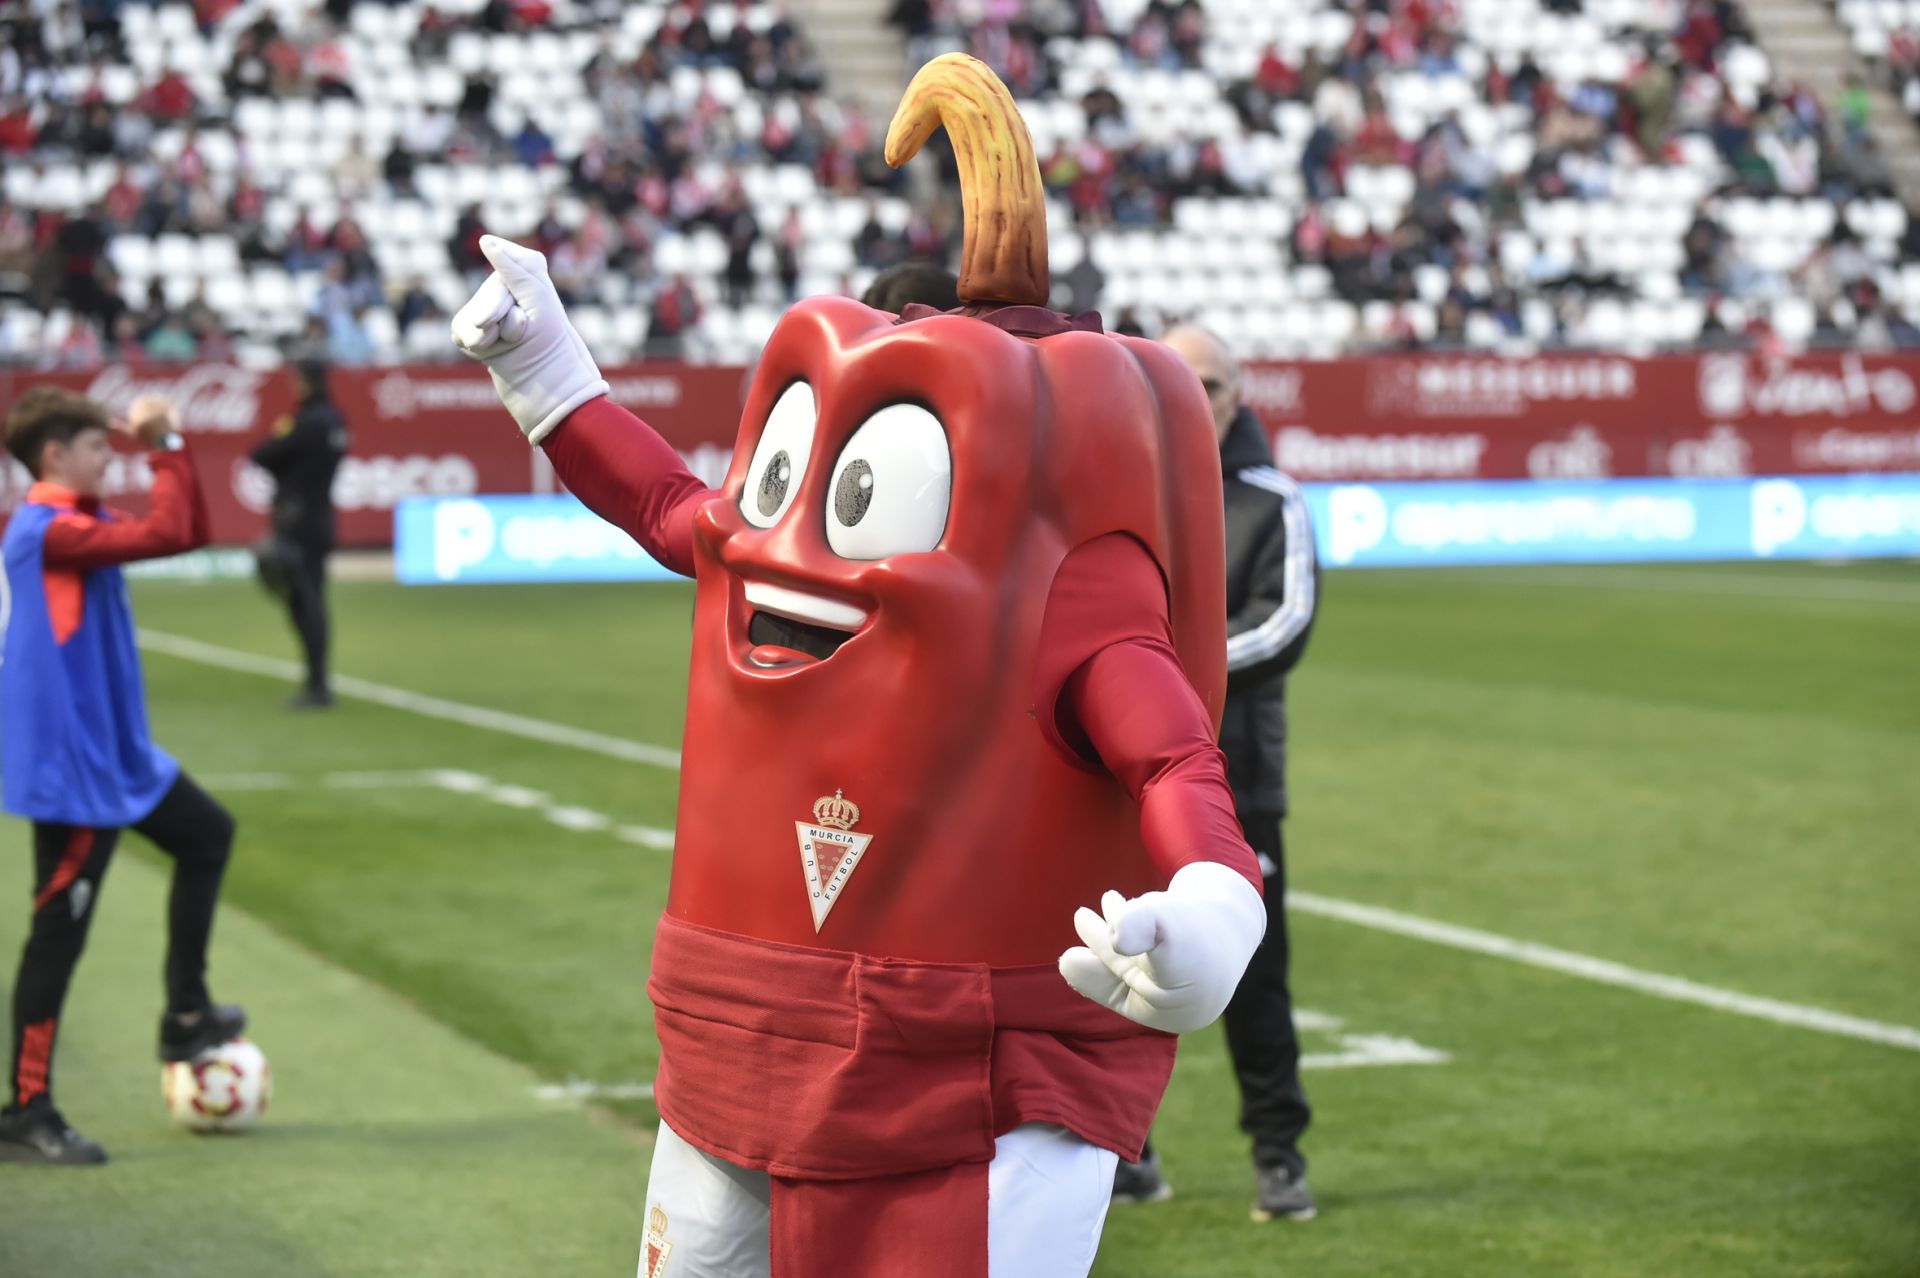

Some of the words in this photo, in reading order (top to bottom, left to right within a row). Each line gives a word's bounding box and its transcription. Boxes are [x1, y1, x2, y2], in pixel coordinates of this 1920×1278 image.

[86, 362, 263, 434] Co-Cola
[1415, 358, 1637, 399] MESEGUER
[809, 829, 855, 844] MURCIA
[804, 843, 821, 898] CLUB
[824, 850, 858, 900] FUTBOL
